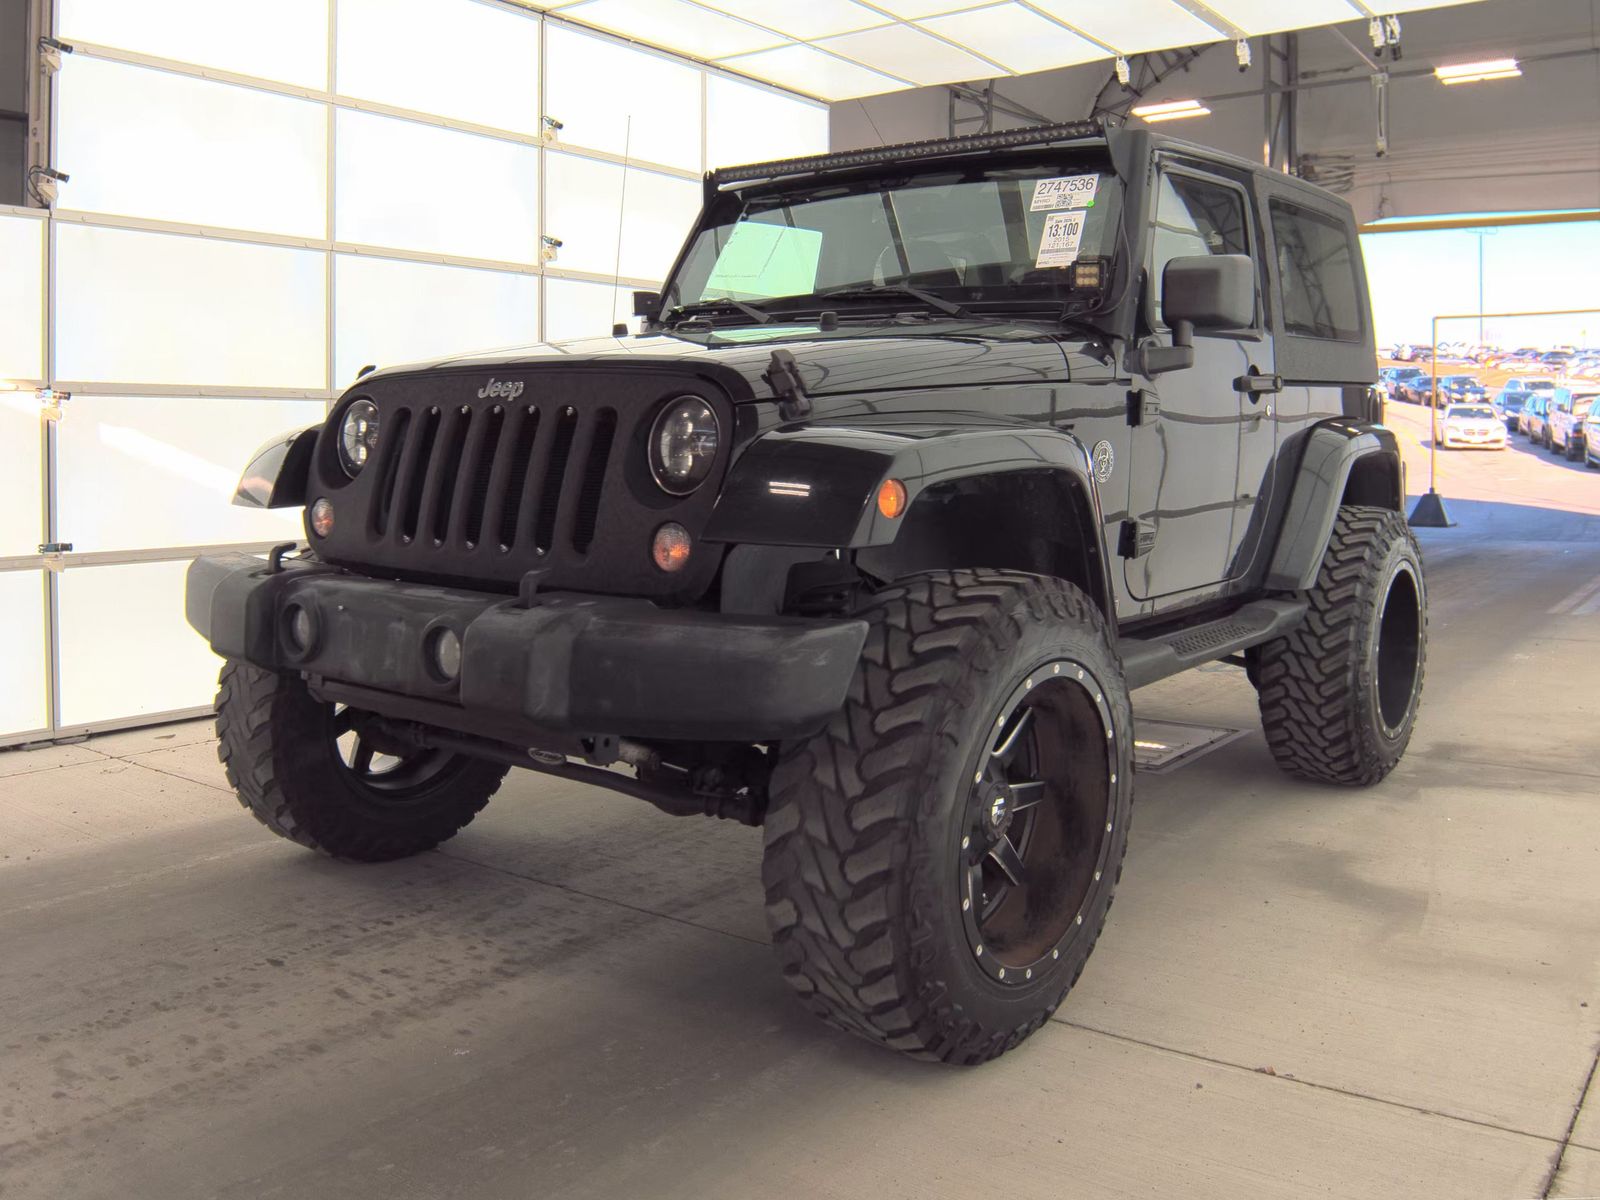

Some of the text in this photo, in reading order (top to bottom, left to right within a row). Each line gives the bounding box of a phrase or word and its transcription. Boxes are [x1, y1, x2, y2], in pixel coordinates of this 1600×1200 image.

[1038, 178, 1095, 195] 2747536
[1048, 222, 1079, 237] 13:100
[477, 378, 524, 401] Jeep
